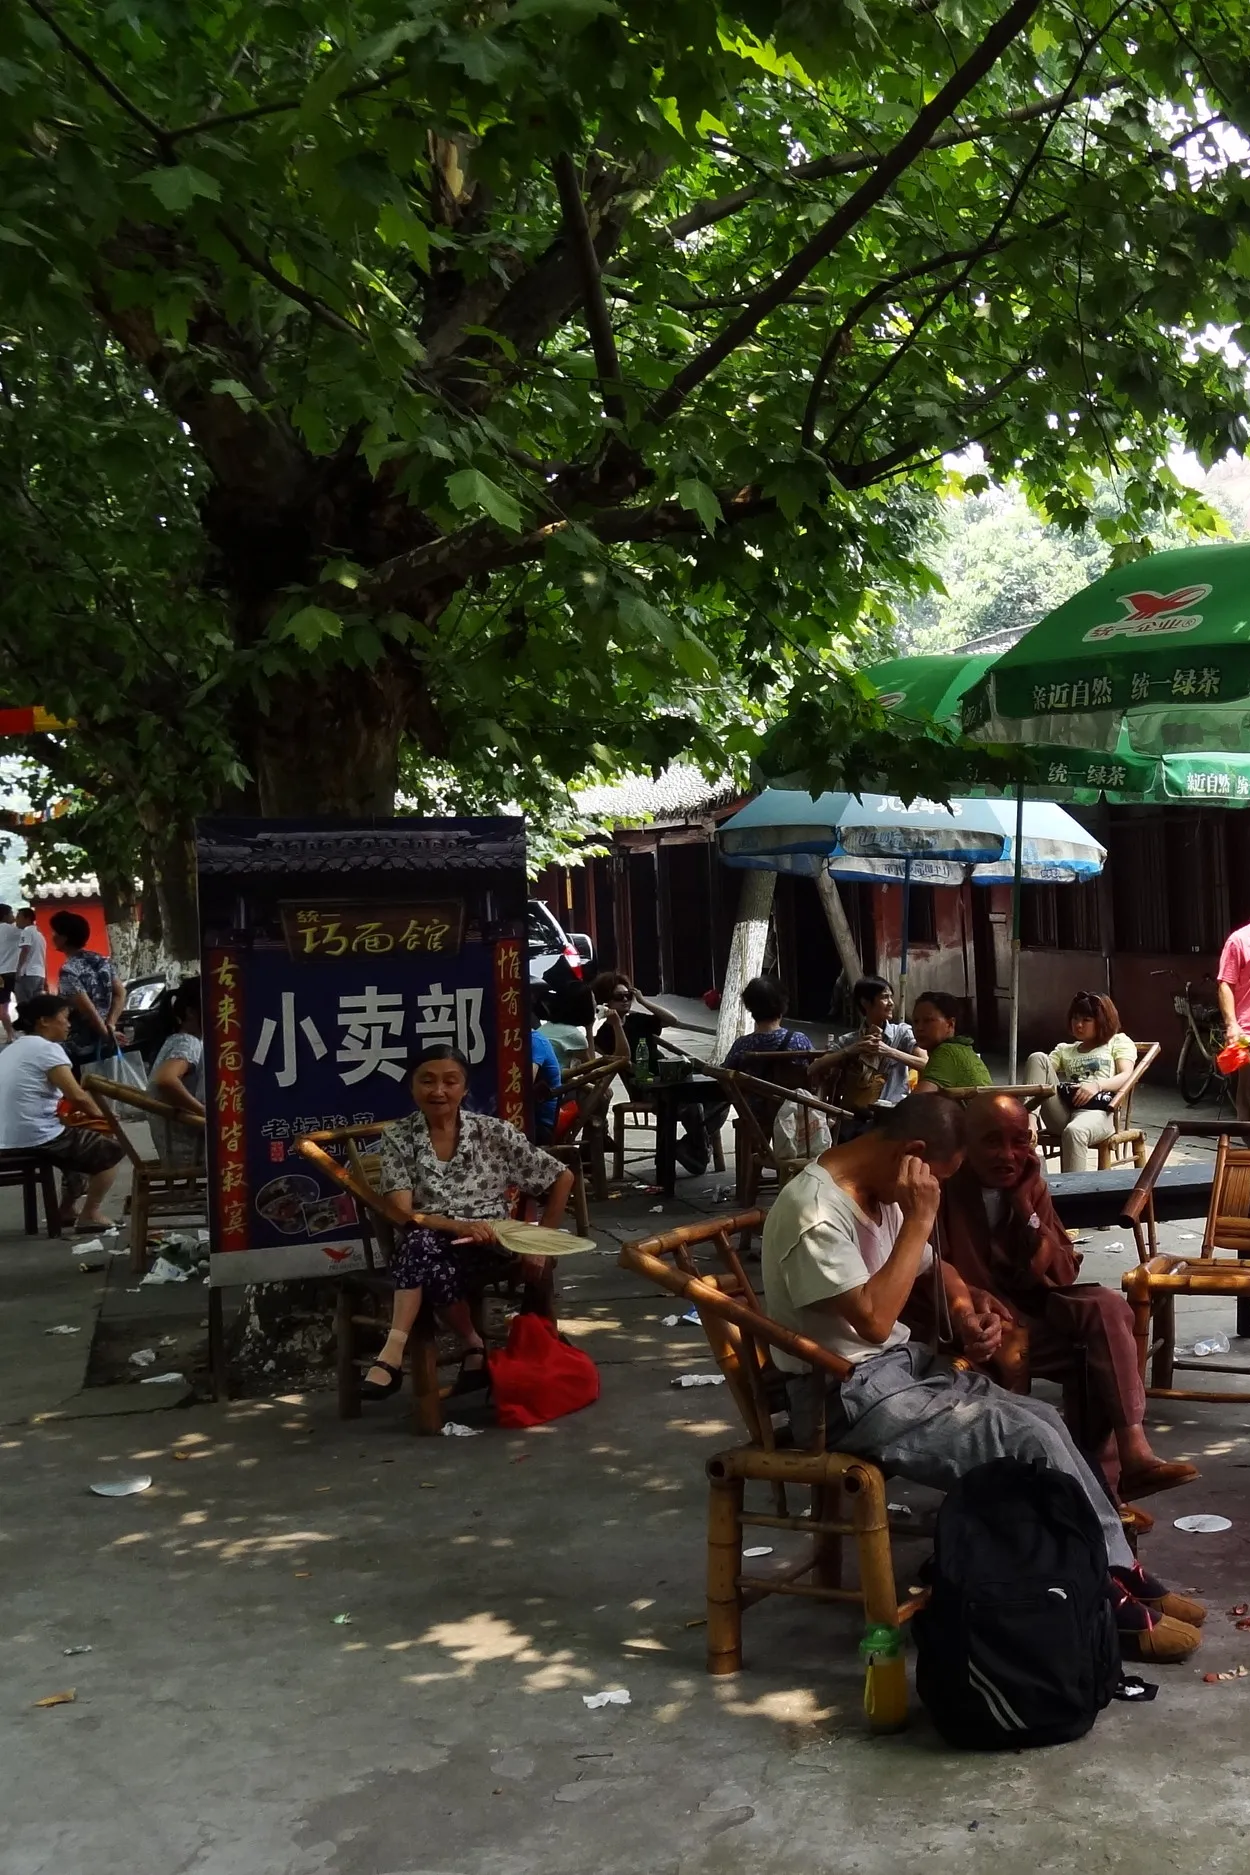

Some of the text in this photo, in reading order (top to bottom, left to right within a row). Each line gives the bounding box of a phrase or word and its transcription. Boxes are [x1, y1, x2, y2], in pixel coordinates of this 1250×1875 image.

[1031, 666, 1222, 711] 亲近自然 统一绿茶
[1047, 760, 1127, 787] 统一绿茶
[297, 918, 452, 957] 巧面馆
[251, 981, 489, 1089] 小卖部
[210, 955, 249, 1237] 古来面馆皆寂寞
